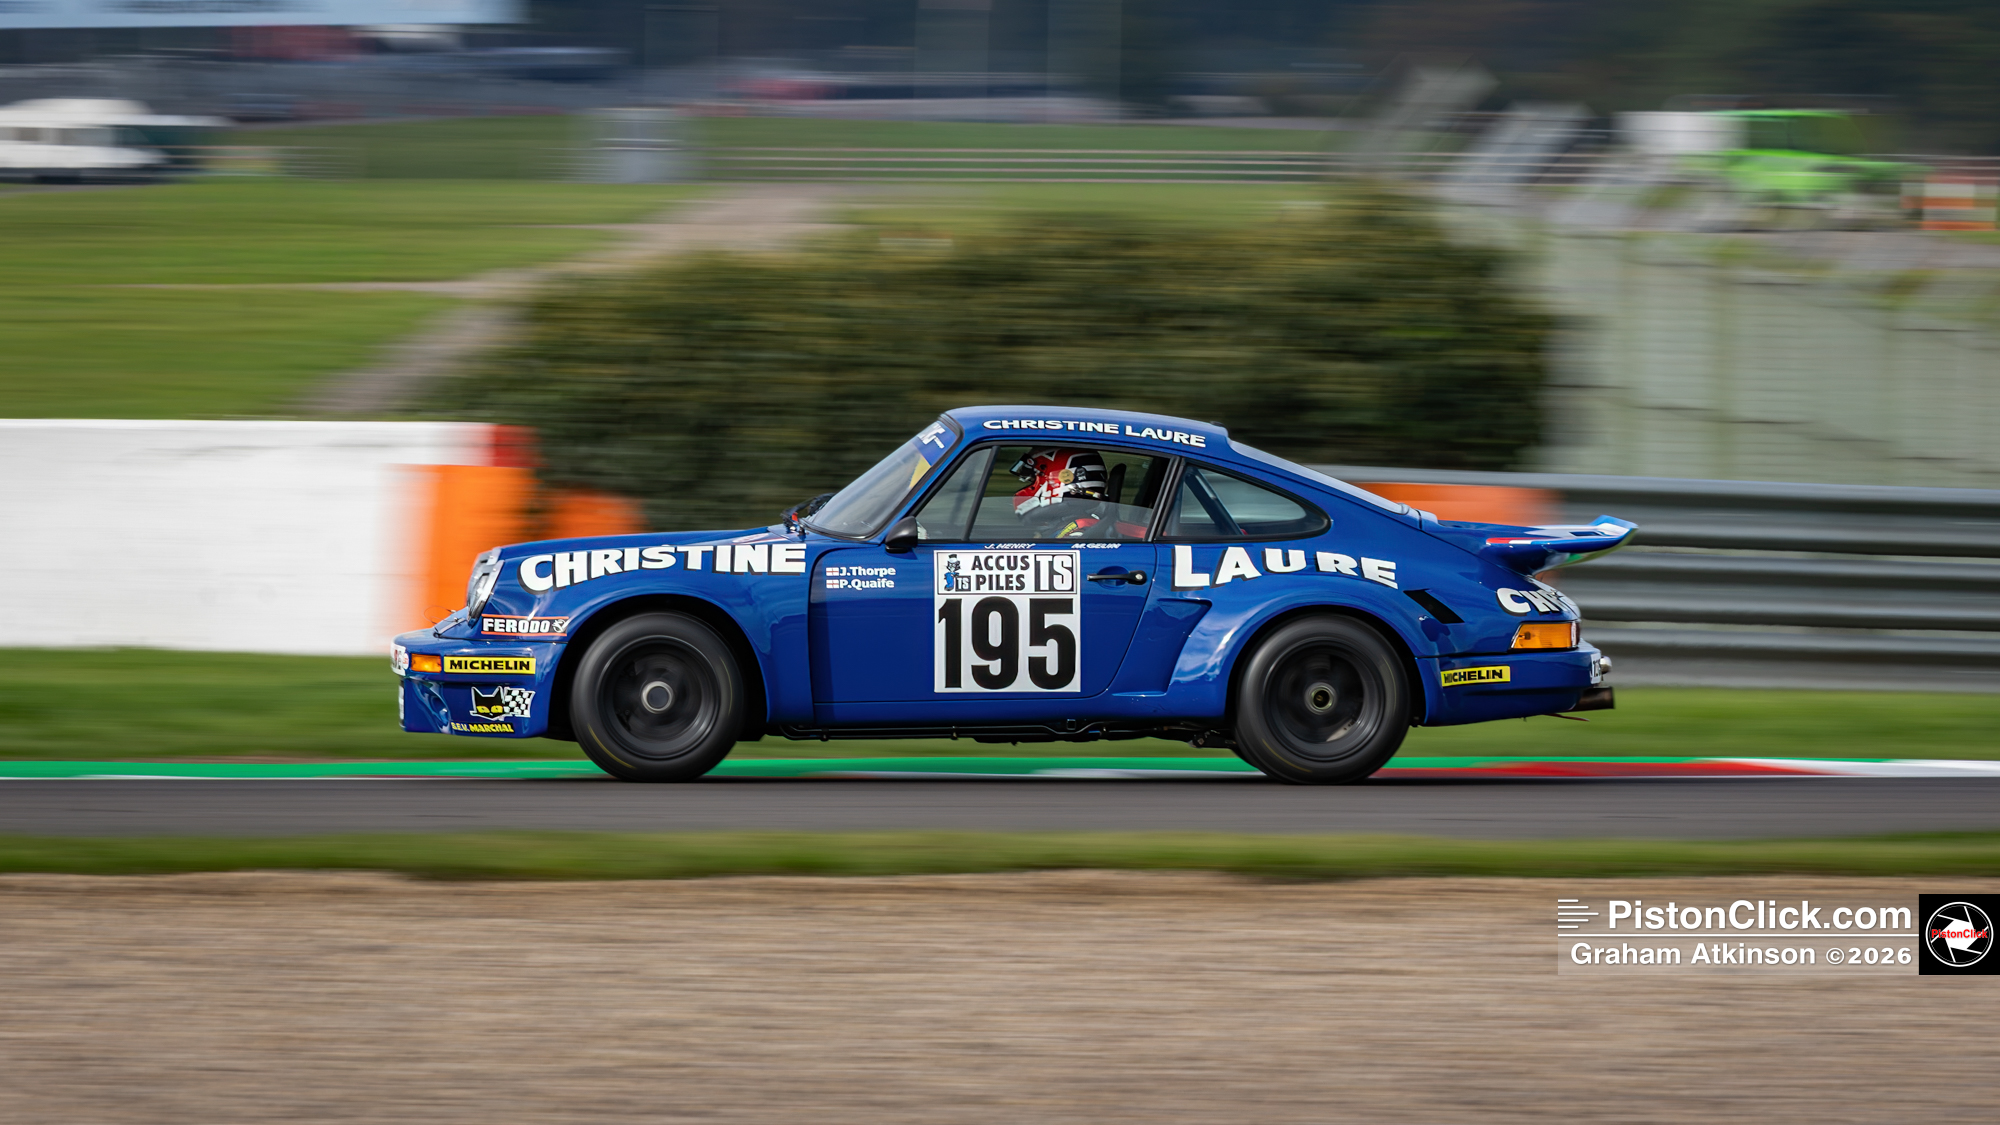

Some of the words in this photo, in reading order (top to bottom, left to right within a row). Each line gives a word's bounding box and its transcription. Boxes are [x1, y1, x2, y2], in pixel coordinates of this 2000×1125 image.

[982, 420, 1119, 434] CHRISTINE
[1125, 425, 1206, 447] LAURE
[520, 543, 807, 592] CHRISTINE
[971, 555, 1030, 571] ACCUS
[1174, 545, 1398, 589] LAURE
[840, 566, 896, 577] J.Thorpe
[1035, 555, 1073, 591] TS
[840, 578, 894, 590] P.Quaife
[957, 577, 970, 590] TS
[975, 574, 1026, 591] PILES
[482, 618, 551, 633] FERODO
[938, 596, 1077, 690] 195
[450, 660, 530, 671] MICHELIN
[1443, 669, 1503, 684] MICHELIN
[469, 723, 514, 733] MARCHAL
